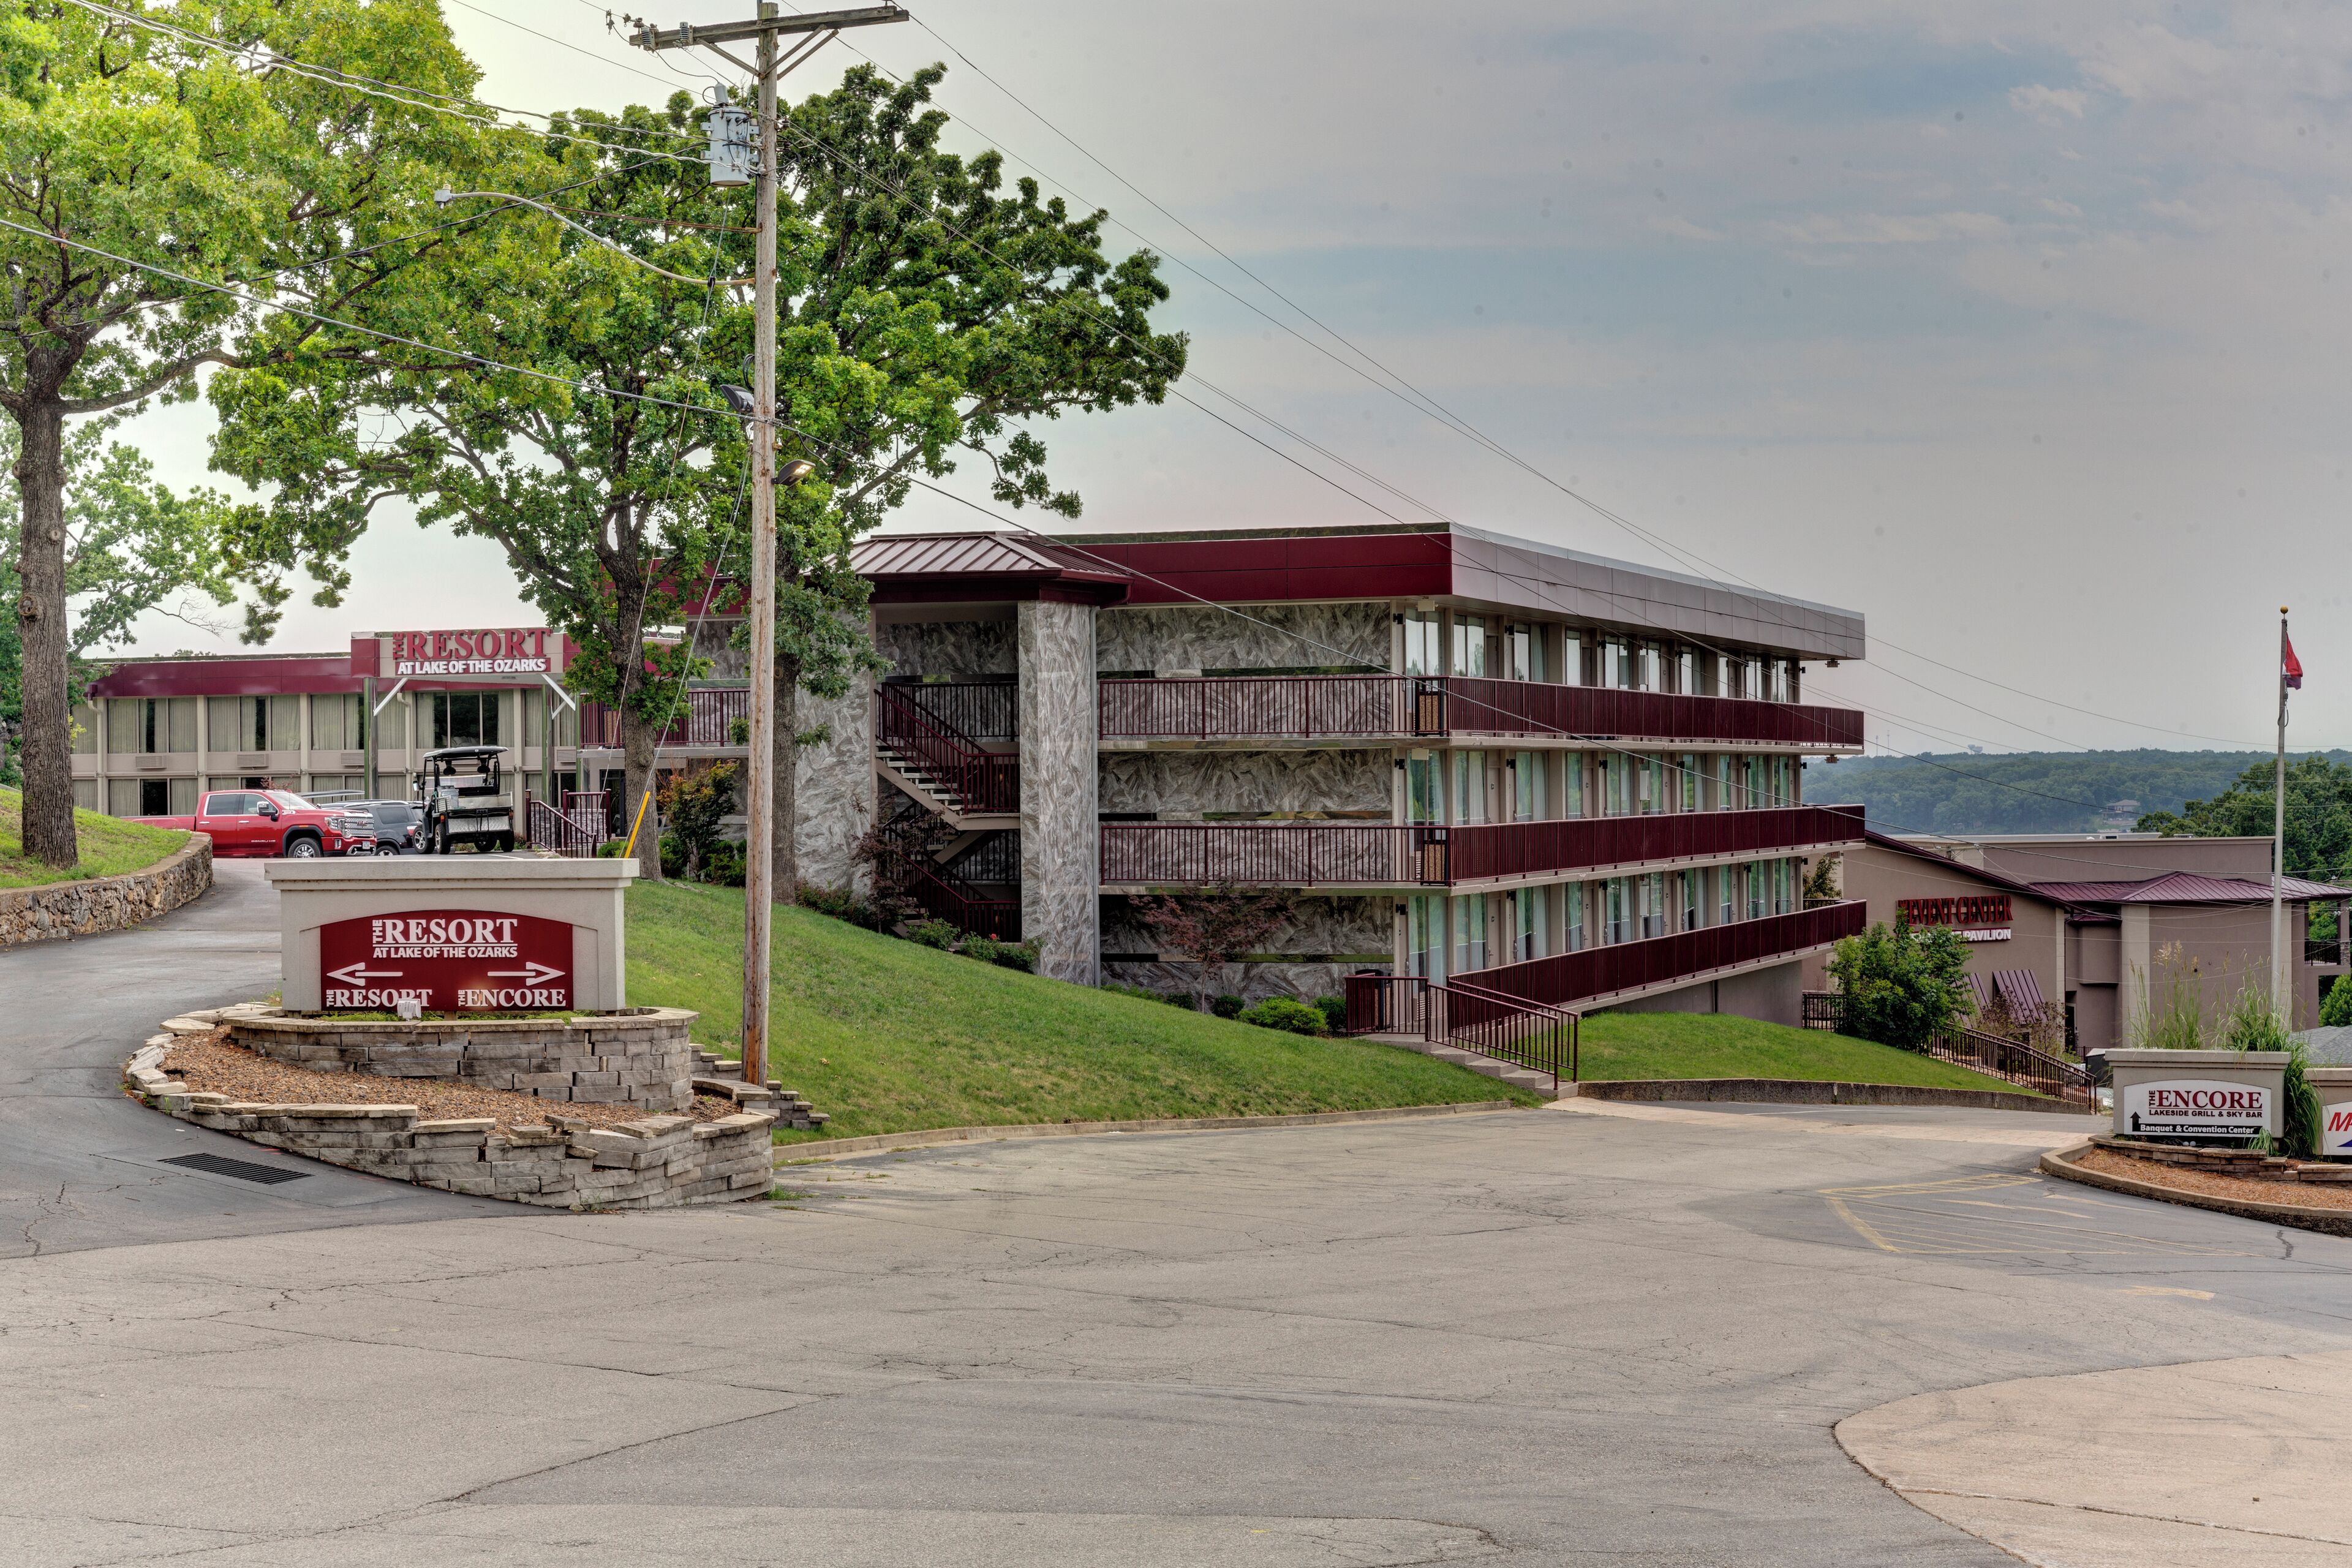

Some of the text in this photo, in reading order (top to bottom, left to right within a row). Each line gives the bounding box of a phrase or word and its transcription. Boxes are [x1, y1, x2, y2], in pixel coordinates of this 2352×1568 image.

[393, 629, 552, 660] THE RESORT
[398, 658, 546, 675] AT LAKE OF THE OZARKS
[1907, 898, 1954, 924] EVENT
[1956, 895, 2013, 924] CENTER
[372, 919, 518, 944] THE RESORT
[1962, 929, 2011, 941] PAVILION
[373, 947, 518, 958] AT LAKE OF THE OZARKS
[466, 989, 566, 1008] ENCORE
[2157, 1090, 2263, 1109] ENCORE
[2140, 1125, 2173, 1133] Banquet
[2183, 1125, 2227, 1134] Convention
